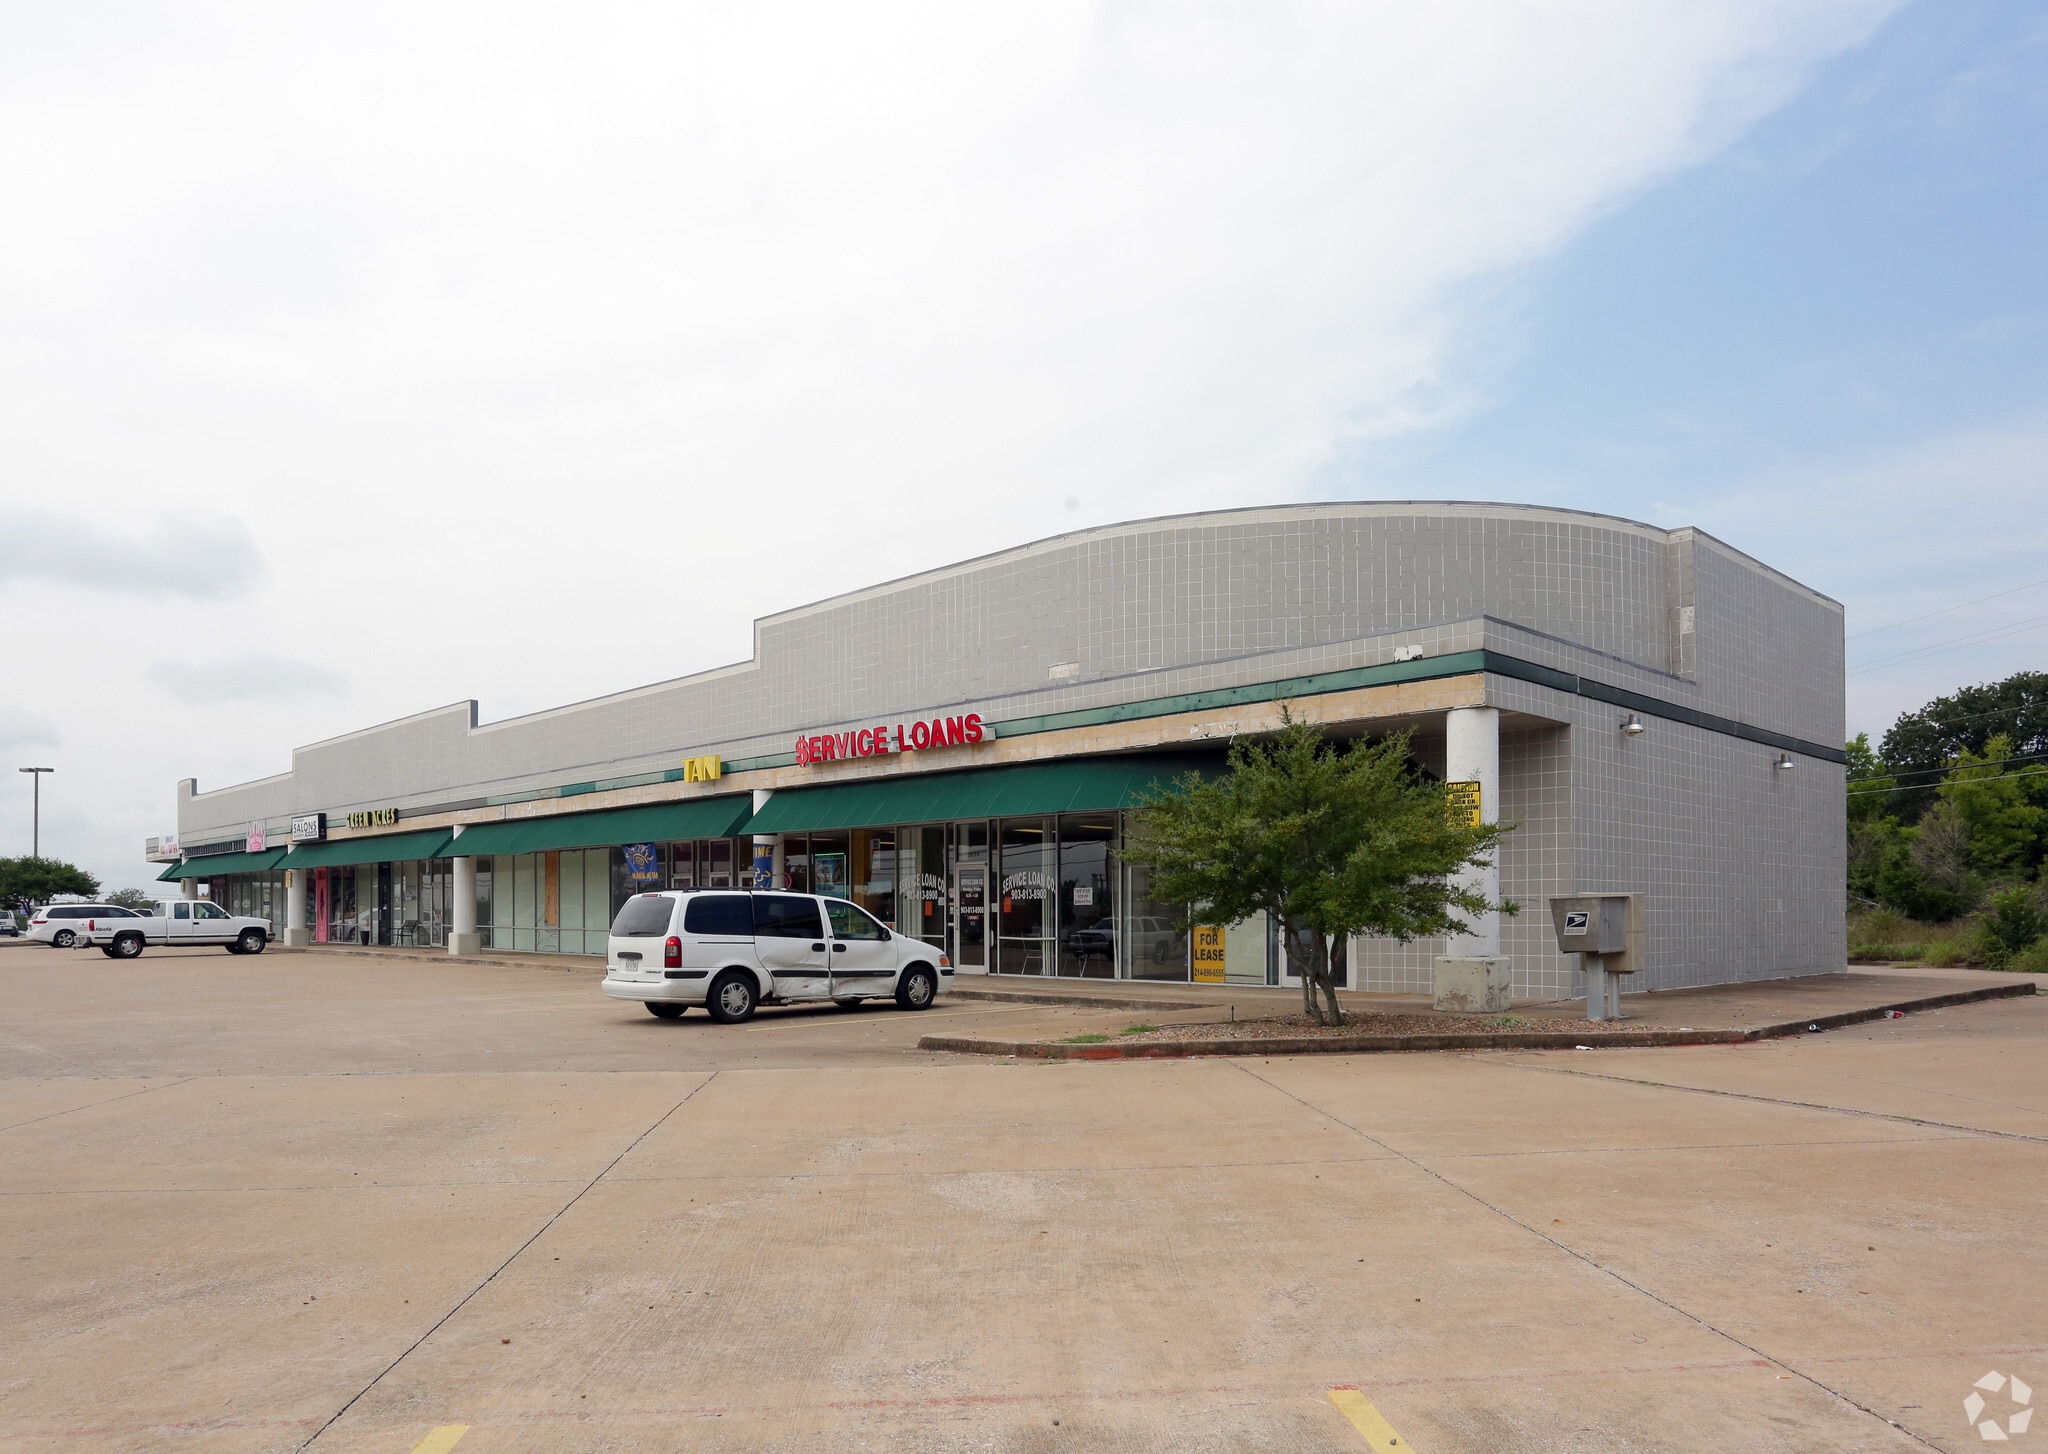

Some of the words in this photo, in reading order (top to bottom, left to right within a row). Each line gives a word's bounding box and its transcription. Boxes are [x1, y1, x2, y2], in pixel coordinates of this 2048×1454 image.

[796, 726, 888, 767] $ERVICE
[898, 713, 986, 751] LOANS
[682, 754, 720, 783] TAN
[1447, 783, 1479, 792] CAUTION
[345, 811, 370, 829] GREEN
[372, 808, 396, 826] ACRES
[293, 820, 317, 834] SALONS
[921, 873, 937, 888] LOAN
[1003, 871, 1027, 895] SERVICE
[1028, 871, 1046, 887] LOAN
[906, 889, 939, 900] 903-813-8900
[1011, 889, 1047, 900] 903-813-8900
[961, 906, 984, 914] 903-813-8900
[1200, 933, 1218, 945] FOR
[1195, 949, 1224, 961] LEASE
